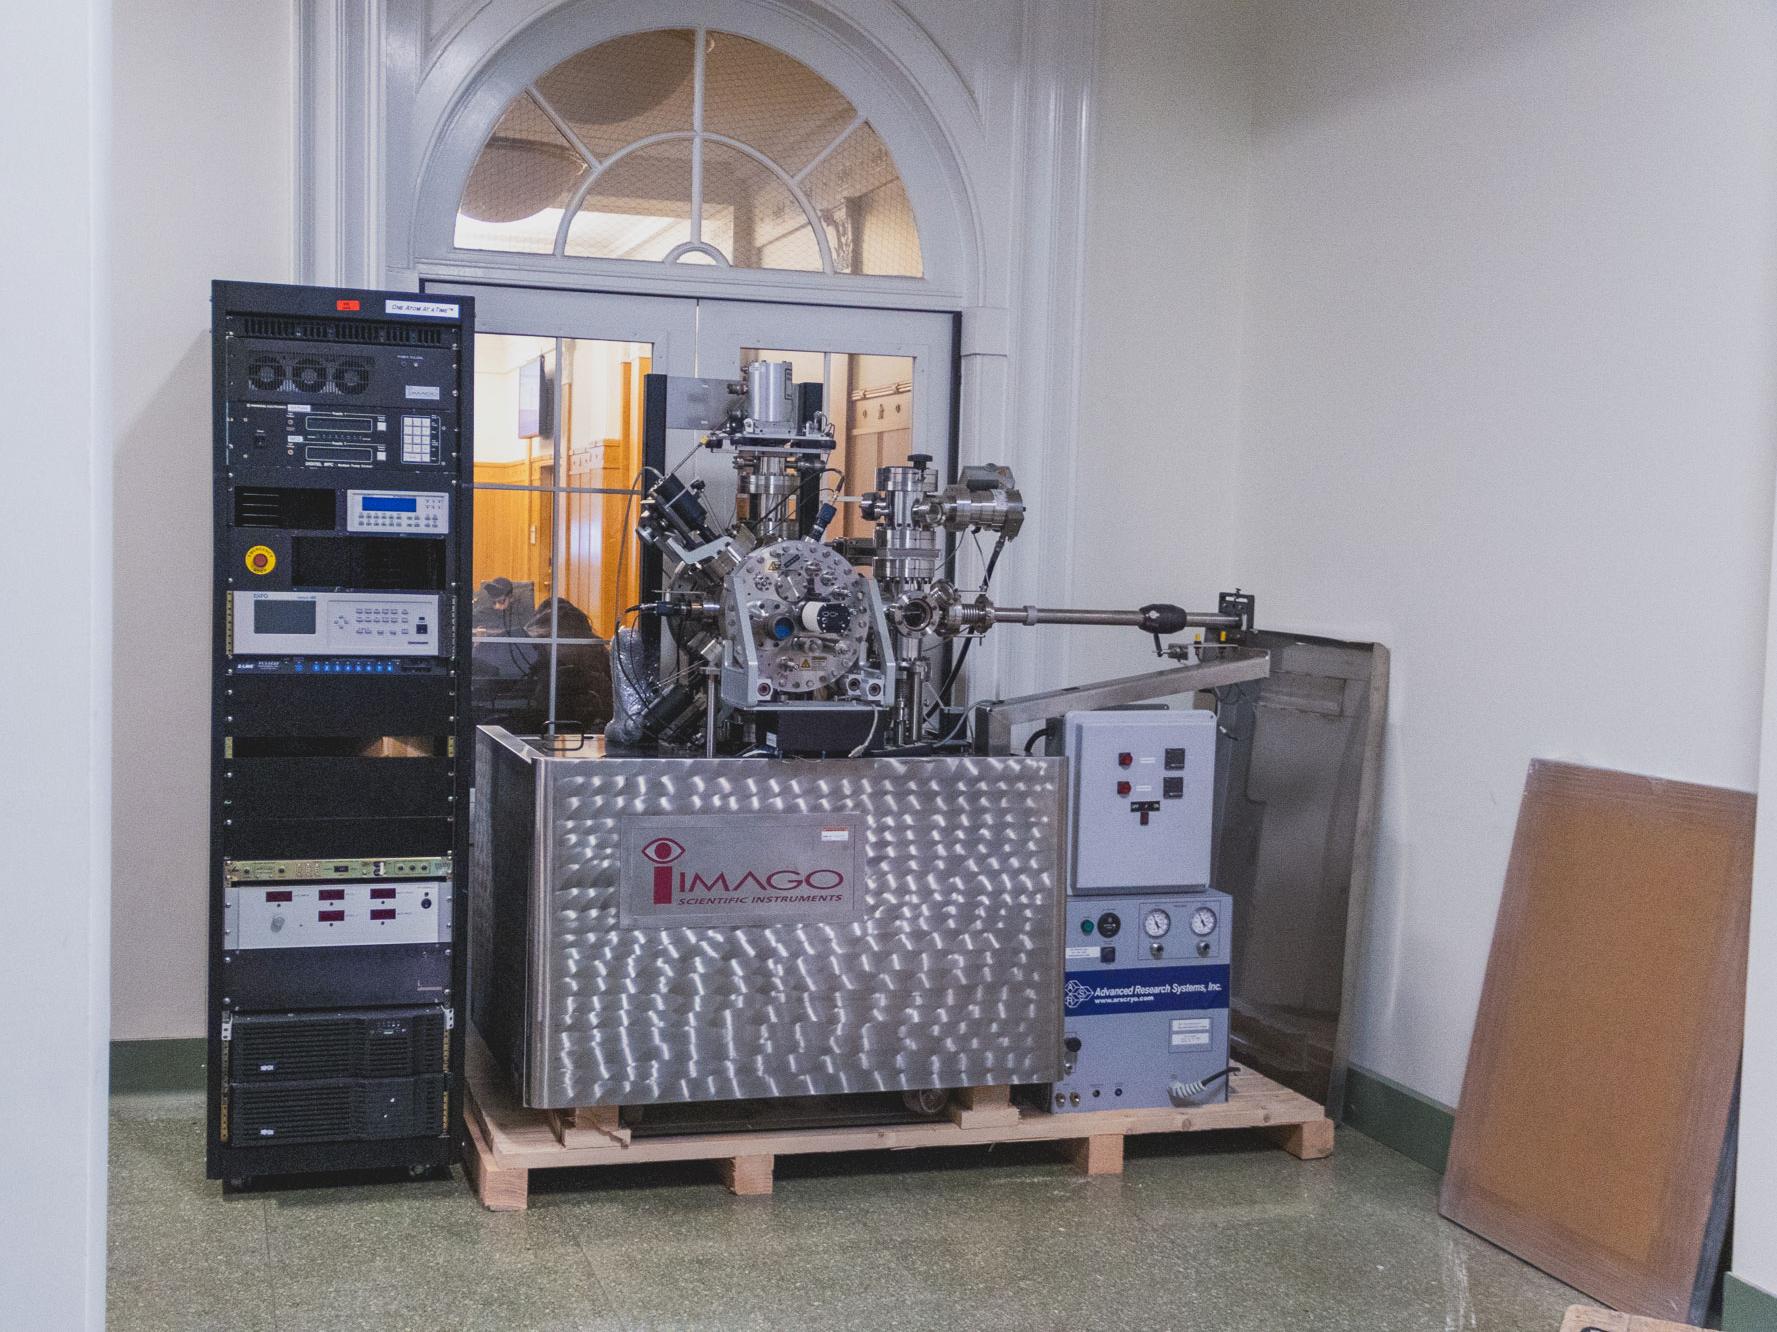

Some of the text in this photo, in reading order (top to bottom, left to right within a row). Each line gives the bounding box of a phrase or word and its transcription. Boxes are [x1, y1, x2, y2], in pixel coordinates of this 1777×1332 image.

[679, 869, 844, 893] IMAGO
[678, 894, 843, 906] SCIENTIFIC INSTRUMENTS
[1094, 981, 1222, 997] Advanced Research Systems, Inc.
